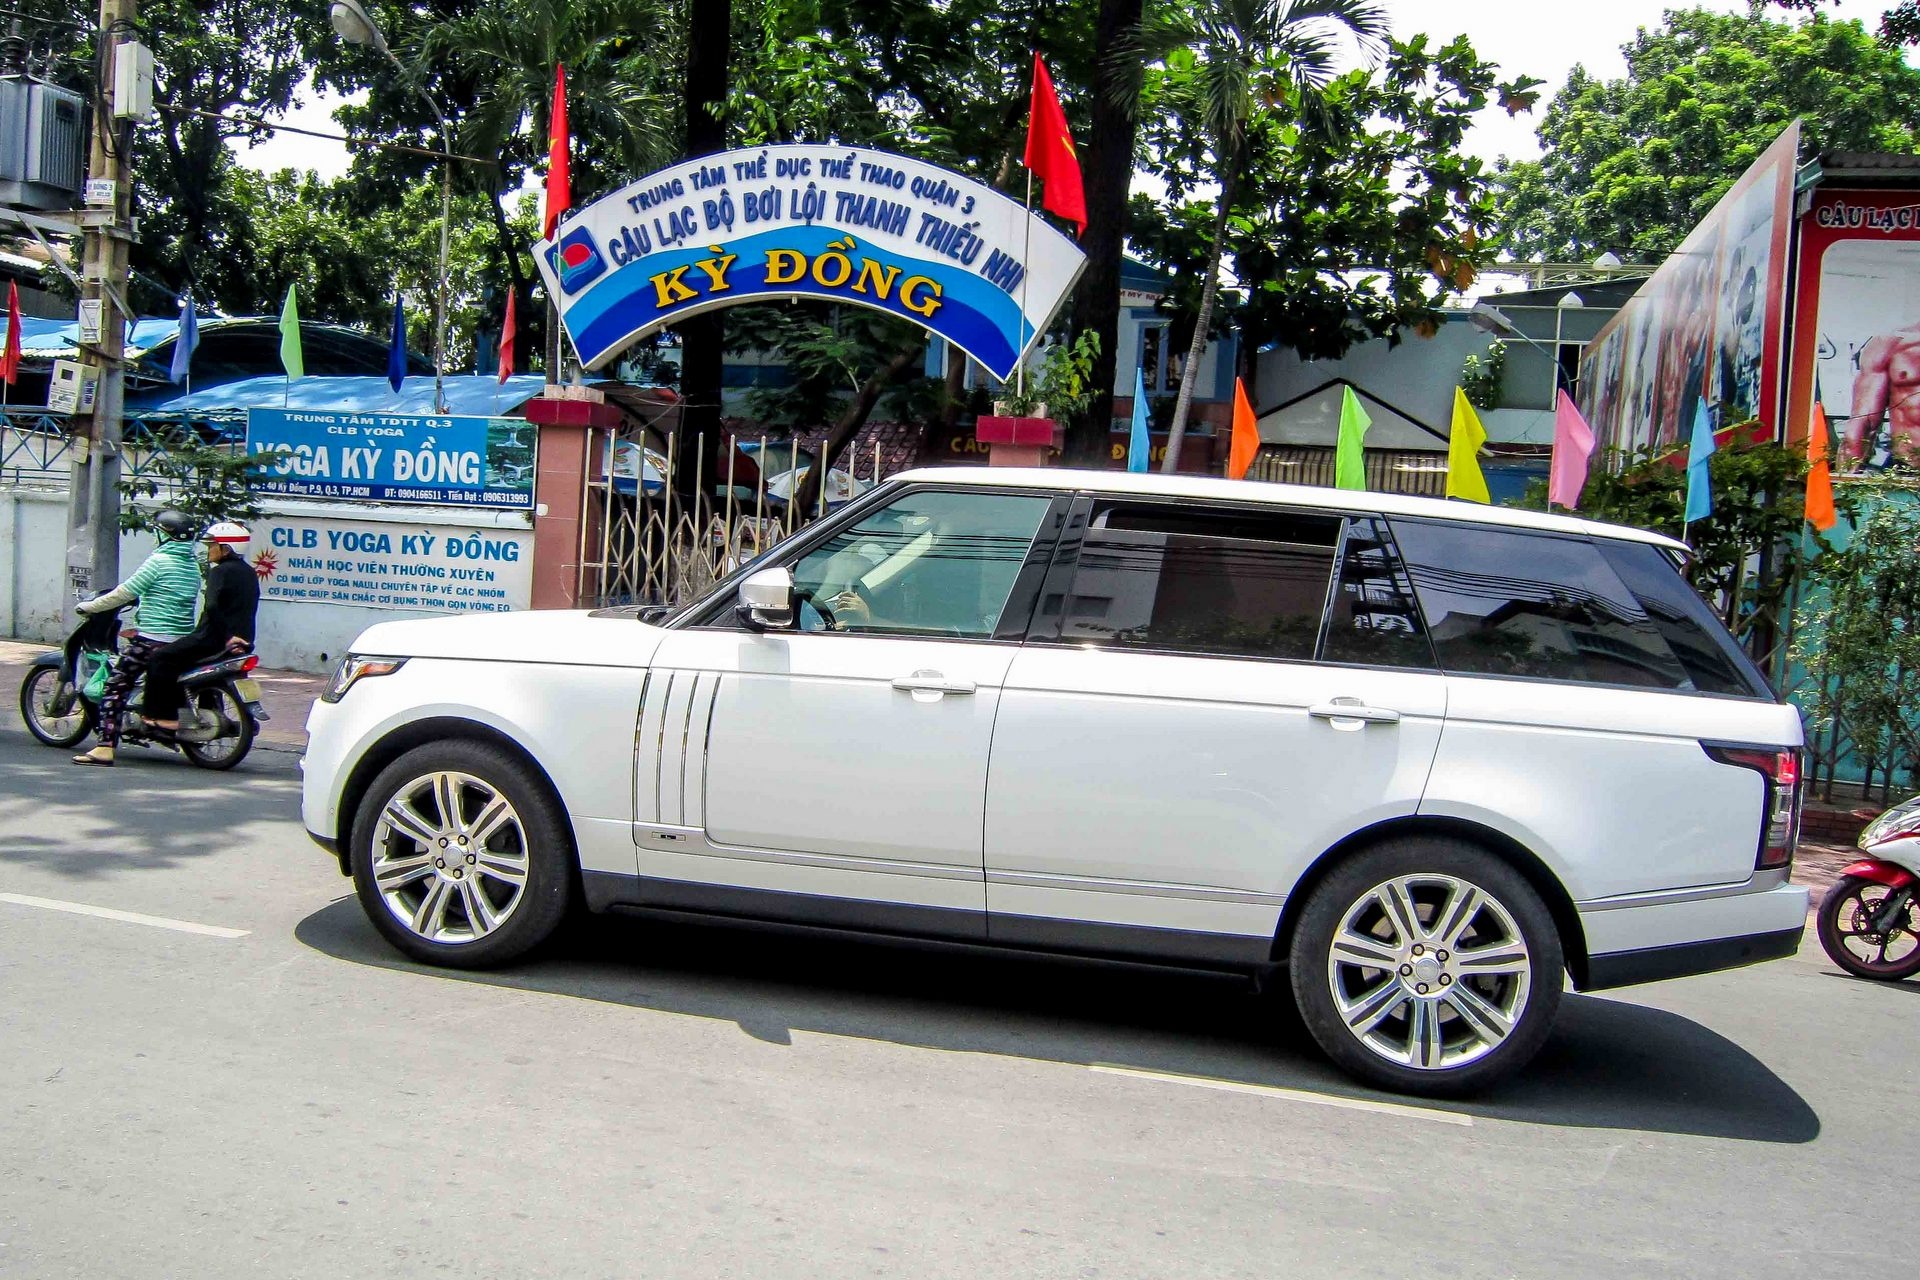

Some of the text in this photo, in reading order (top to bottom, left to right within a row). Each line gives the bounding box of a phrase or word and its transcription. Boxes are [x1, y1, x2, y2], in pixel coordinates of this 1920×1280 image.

[627, 150, 976, 214] TRUNG TÂM THỂ DỤC THỂ THAO QUẬN 3
[1816, 200, 1864, 228] CÂU
[1866, 206, 1913, 234] LẠC
[608, 181, 1026, 294] CÂU LẠC BỘ BƠI LỘI THANH THIẾU NHI
[648, 236, 943, 318] KỲ ĐỒNG
[284, 413, 335, 424] TRUNG
[340, 414, 374, 425] TÂM
[425, 419, 453, 428] Q.3
[327, 426, 404, 437] CLB YOGA
[255, 436, 480, 485] YOGA KỲ ĐỒNG
[341, 486, 370, 497] TP.HCM
[271, 527, 519, 562] CLB YOGA KỲ ĐỒNG
[327, 560, 353, 574] HỌC
[357, 561, 387, 575] VIÊN
[392, 563, 445, 578] THƯỜNG
[450, 567, 494, 582] XUYÊN
[327, 579, 350, 588] YOGA
[352, 581, 378, 590] NAULI
[381, 581, 418, 592] CHUYÊN
[477, 587, 505, 599] NHÓM
[420, 598, 445, 607] THON
[447, 600, 467, 611] GỌN
